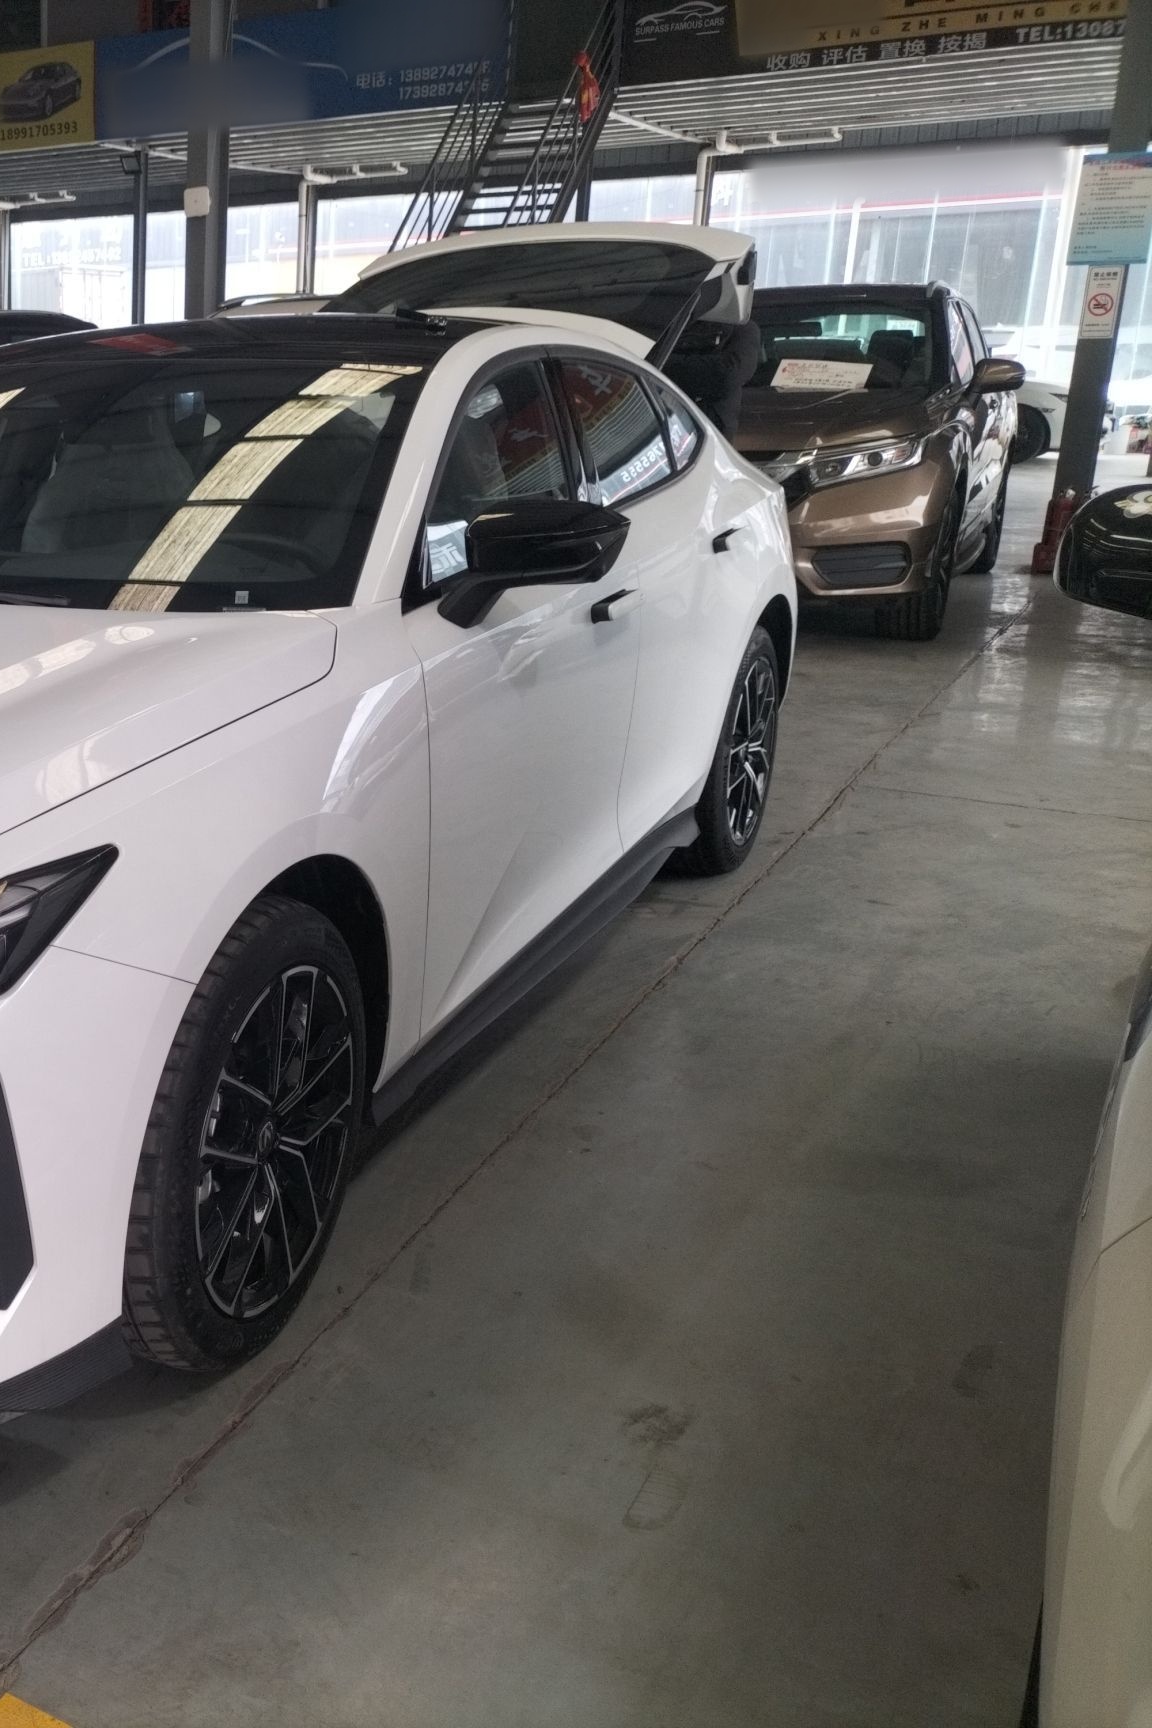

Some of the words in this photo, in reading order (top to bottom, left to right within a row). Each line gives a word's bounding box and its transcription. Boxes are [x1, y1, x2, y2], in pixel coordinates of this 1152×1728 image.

[670, 19, 703, 32] FAMOUS
[704, 17, 725, 28] CARS
[817, 25, 881, 41] XING
[901, 17, 948, 32] ZHE
[975, 6, 1046, 23] MING
[766, 52, 811, 71] 收购
[821, 45, 869, 66] 评估
[879, 39, 927, 60] 置换
[938, 32, 988, 54] 按揭
